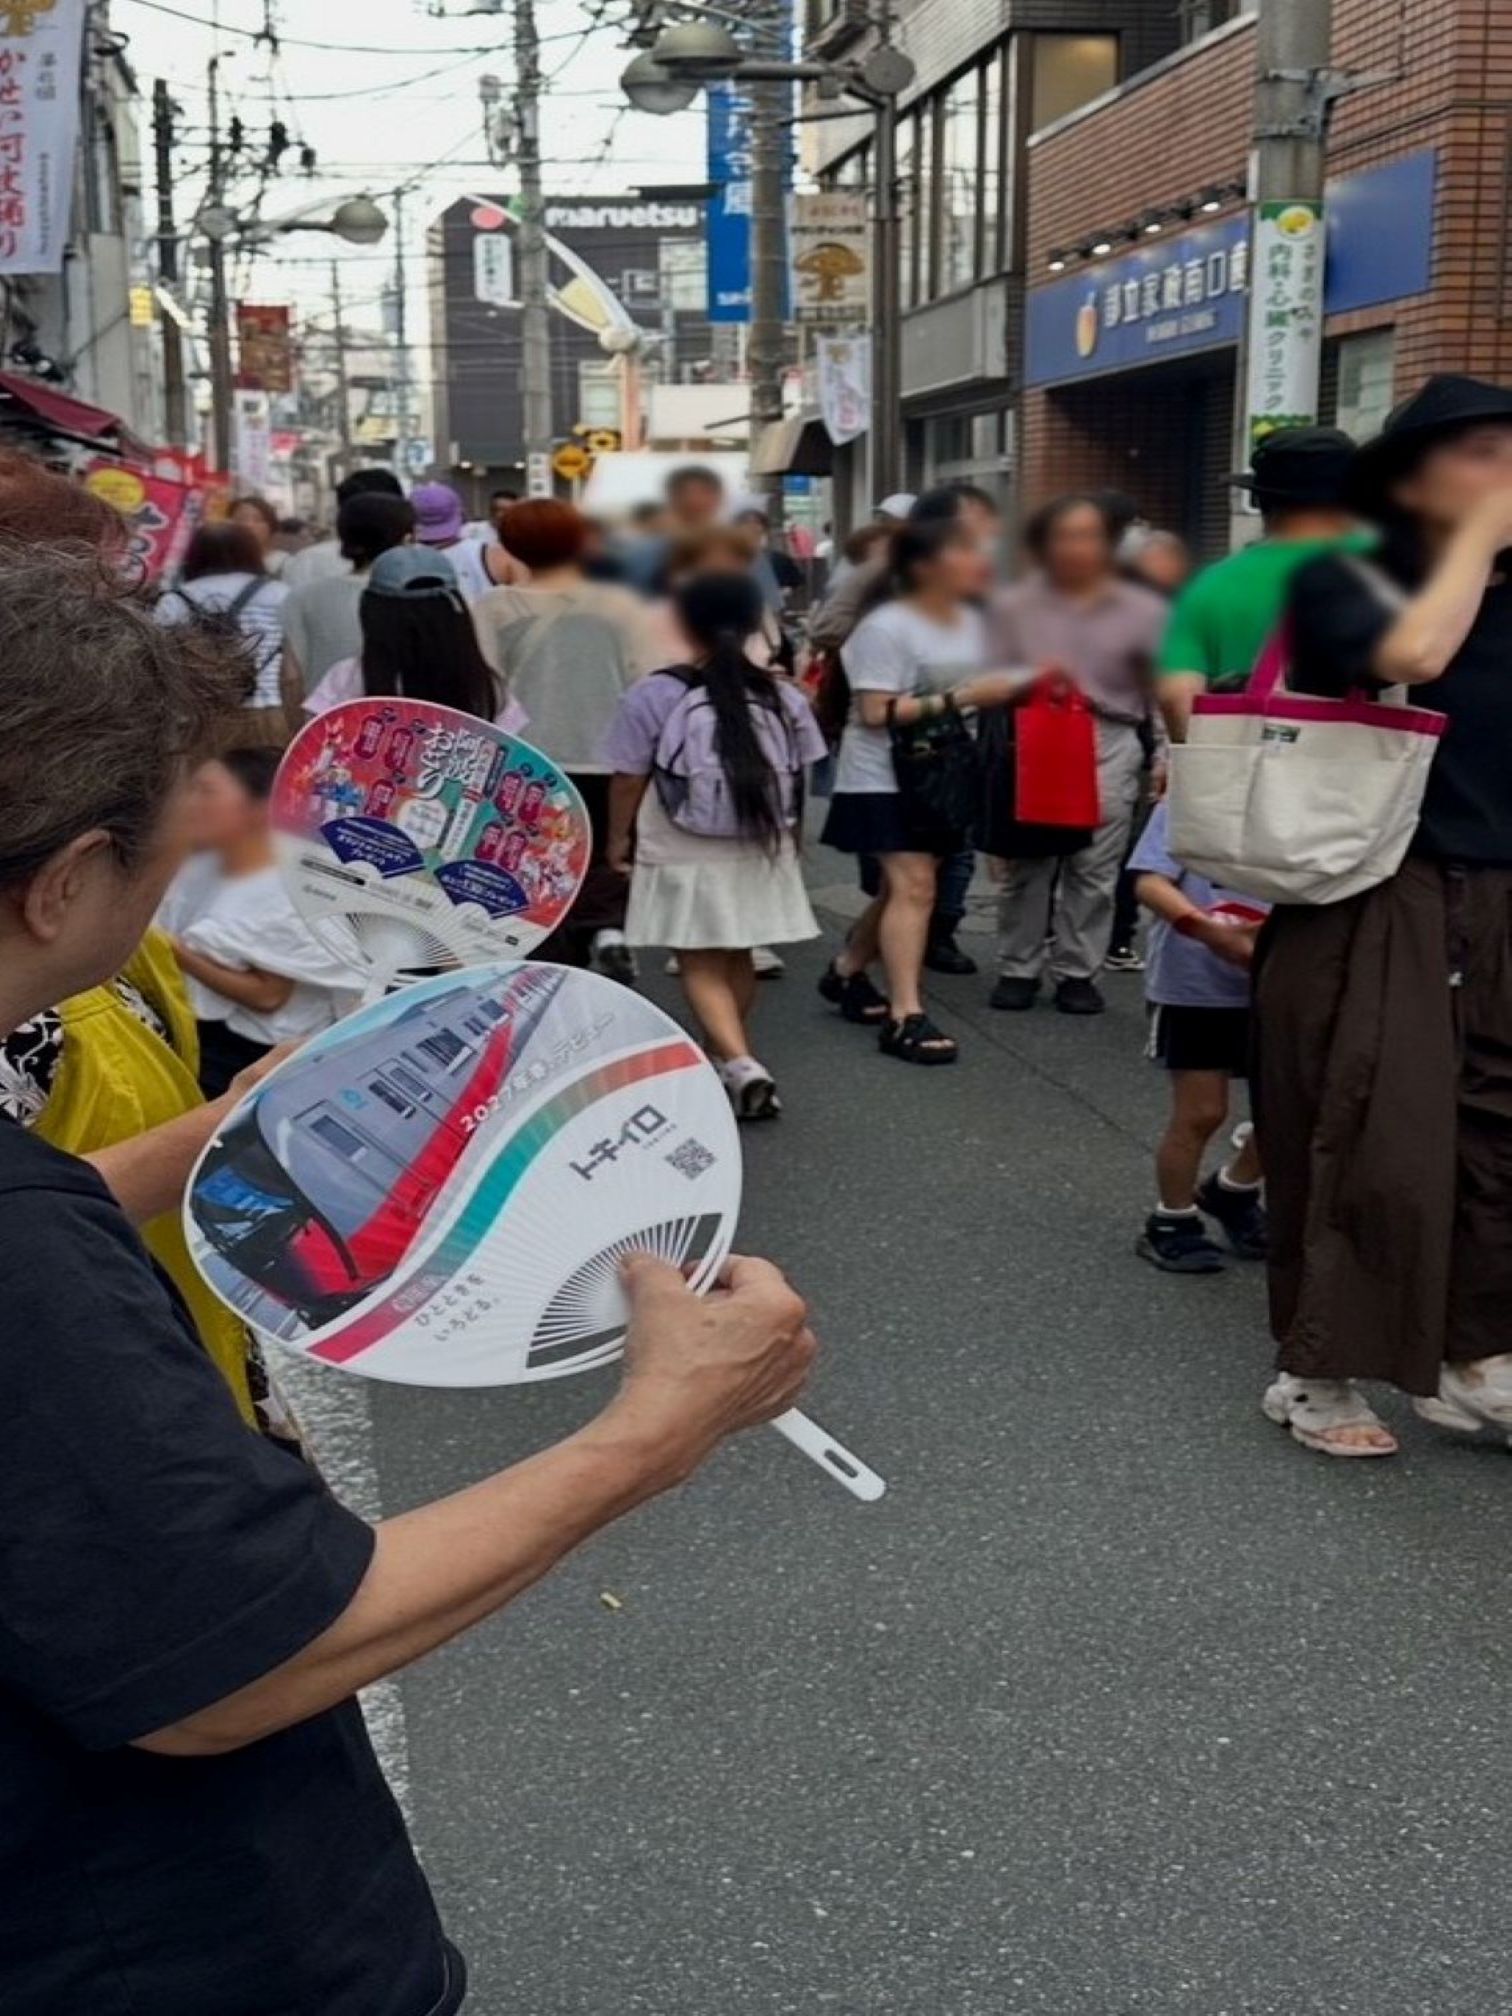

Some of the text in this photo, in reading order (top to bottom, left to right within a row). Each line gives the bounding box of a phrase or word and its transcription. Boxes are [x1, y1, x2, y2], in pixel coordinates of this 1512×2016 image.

[545, 204, 697, 227] maruetsu
[569, 1104, 667, 1181] トキイロ
